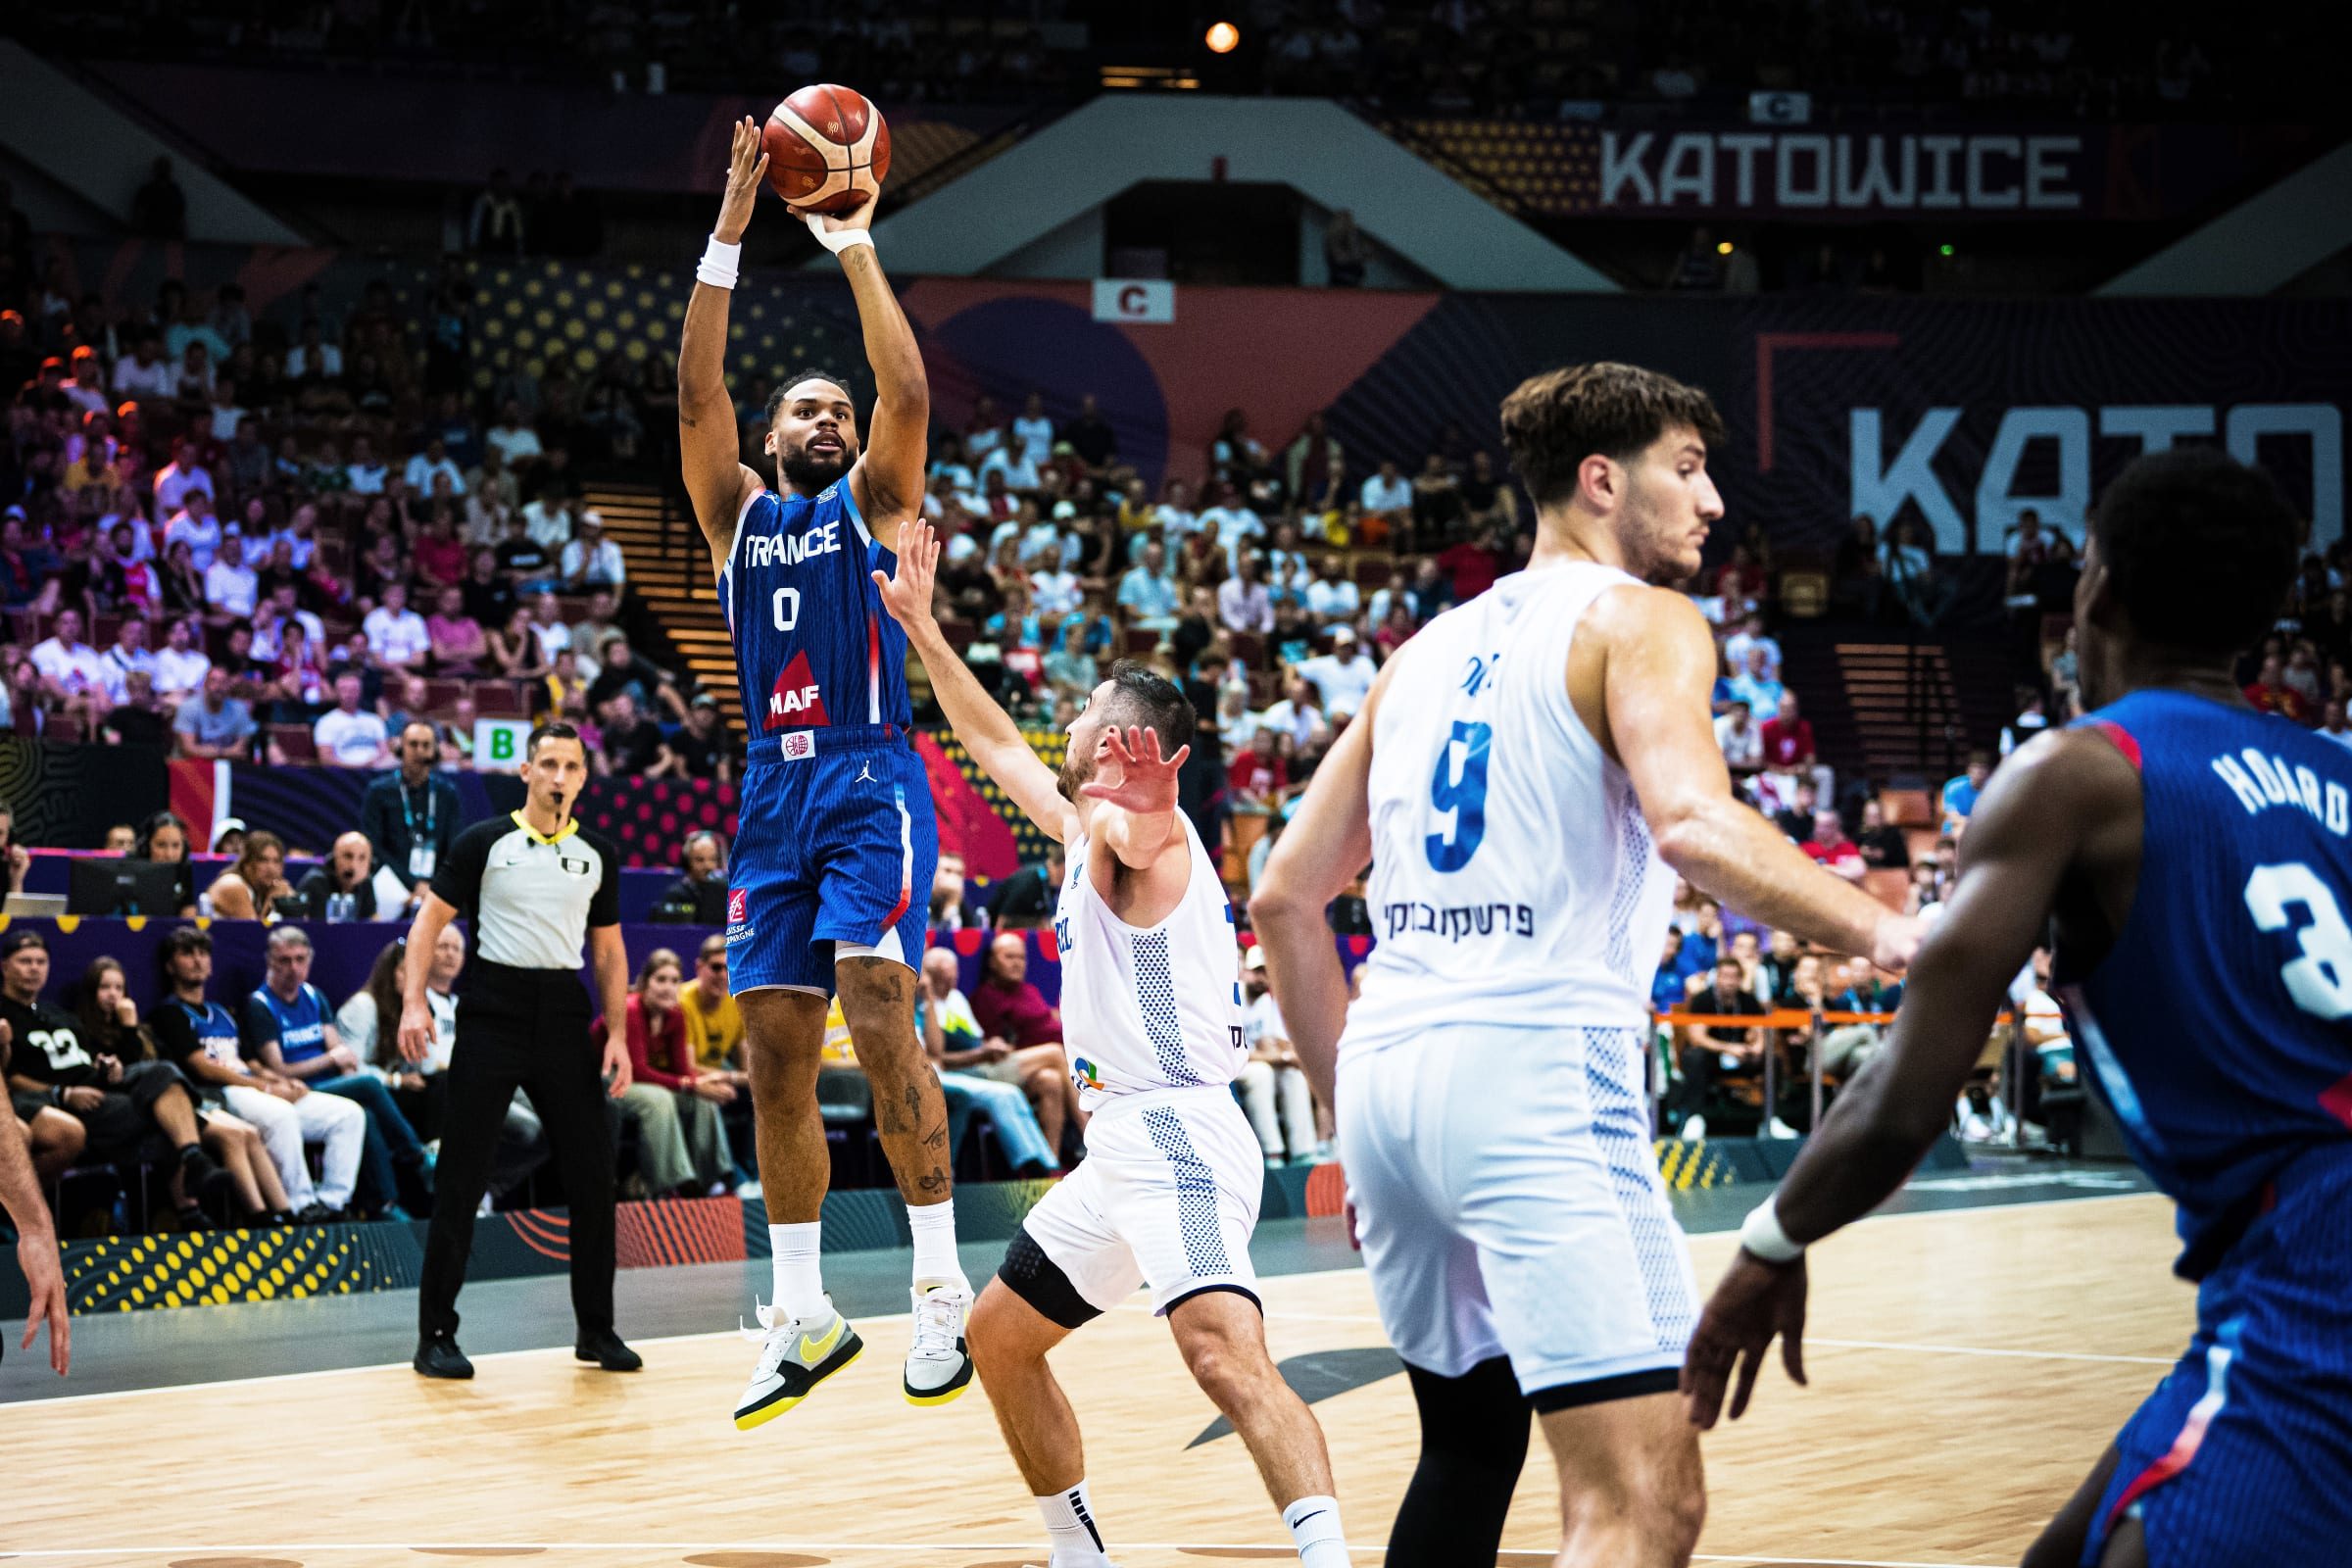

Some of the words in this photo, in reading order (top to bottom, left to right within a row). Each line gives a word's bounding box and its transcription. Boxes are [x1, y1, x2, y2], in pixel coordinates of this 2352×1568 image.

[1767, 97, 1793, 120] C
[1601, 133, 2081, 207] KATOWICE
[1119, 285, 1148, 315] C
[772, 587, 801, 632] 0
[491, 727, 514, 760] B
[1426, 720, 1493, 873] 9
